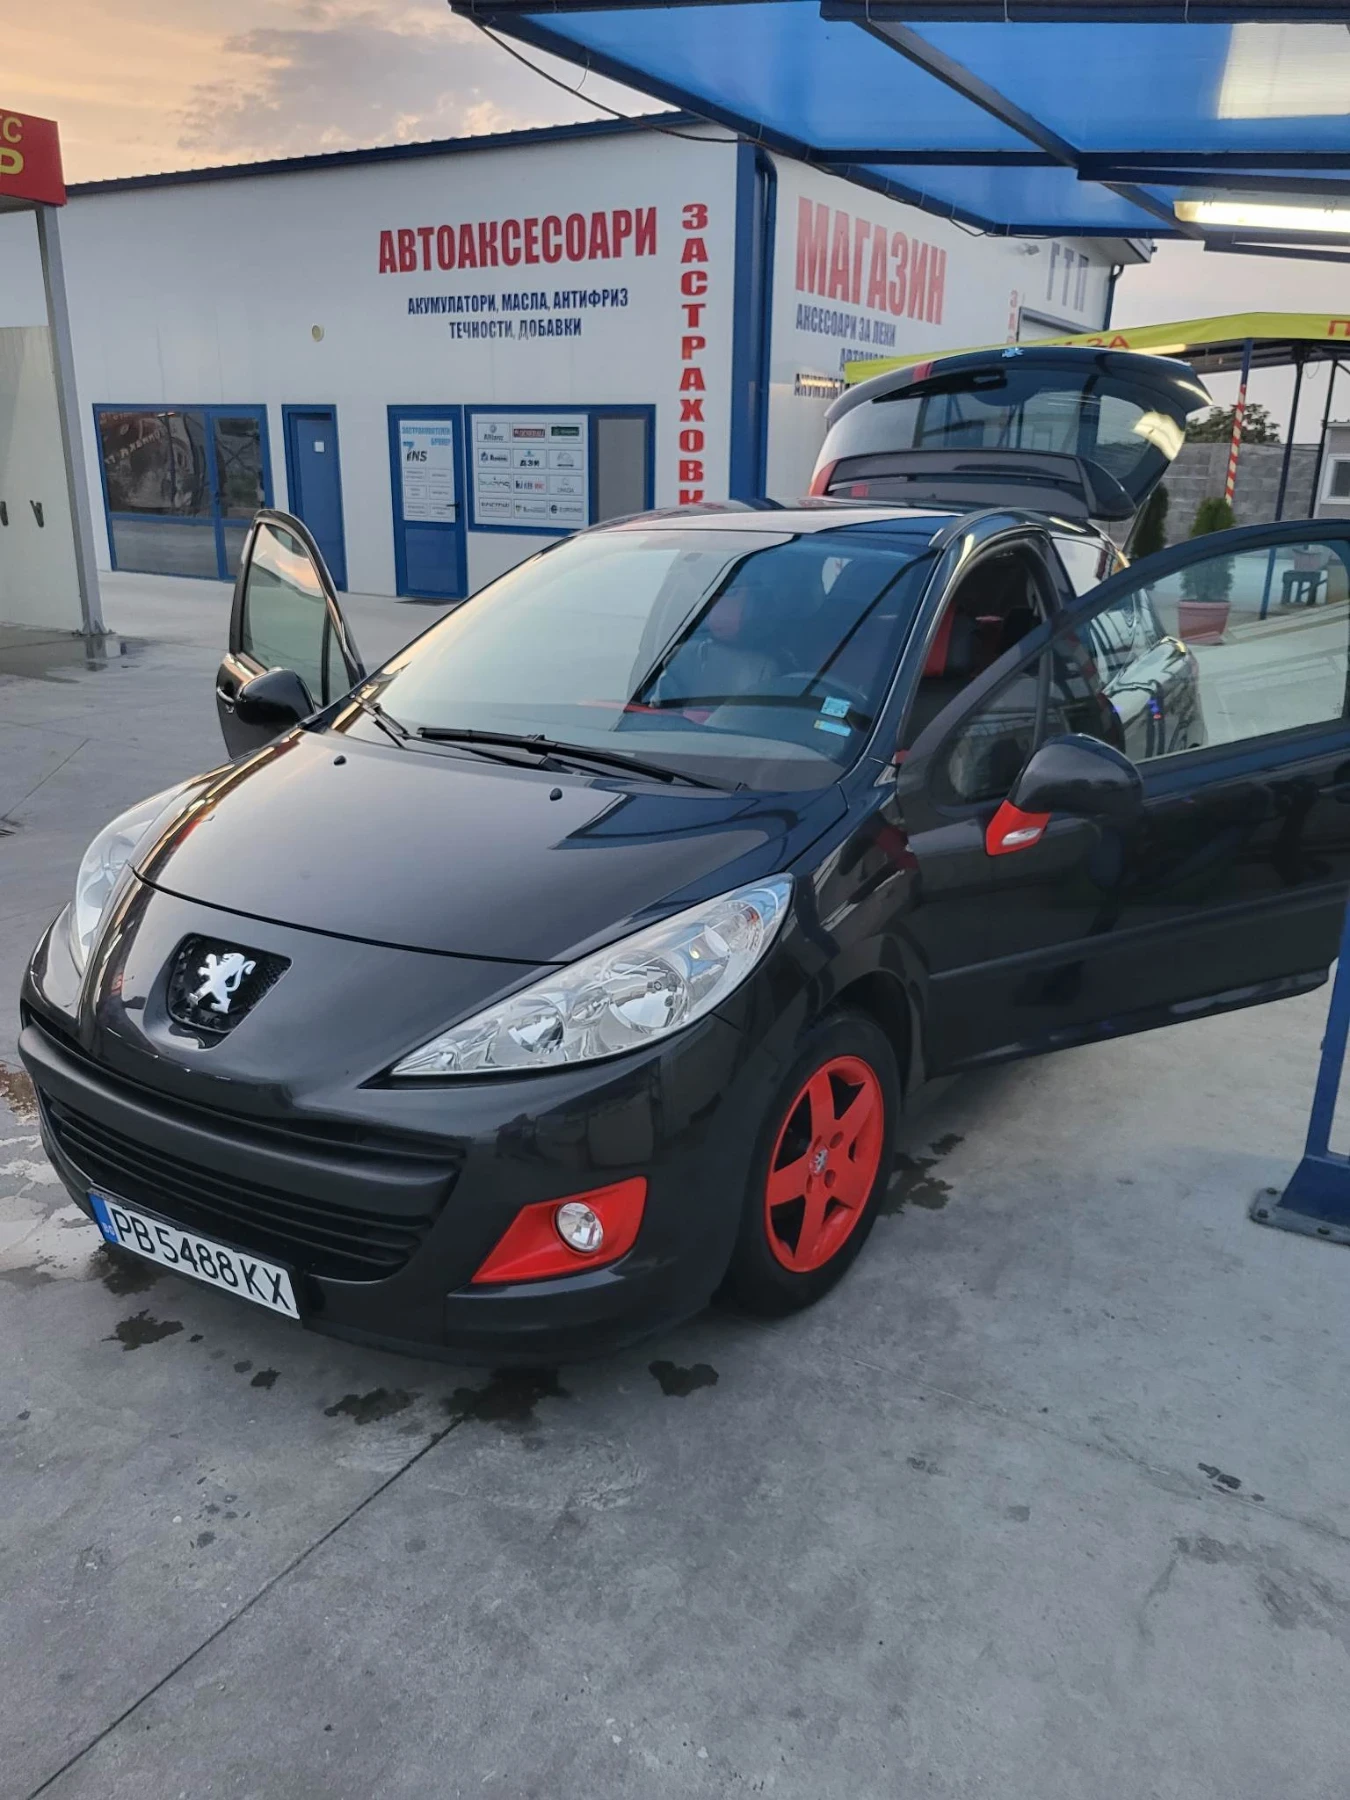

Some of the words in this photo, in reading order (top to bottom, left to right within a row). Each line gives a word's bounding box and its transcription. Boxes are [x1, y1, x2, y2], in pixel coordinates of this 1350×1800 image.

[379, 206, 657, 274] АВТОАКСЕСОАРИ
[795, 195, 947, 326] МАГАЗИН
[408, 294, 499, 315] АКУМУЛАТОРИ,
[502, 291, 550, 312] МАСЛА,
[553, 287, 629, 309] АНТИФРИЗ
[1047, 241, 1090, 313] ГТП
[449, 320, 516, 339] ТЕЧНОСТИ,
[518, 318, 582, 340] ДОБАВКИ
[796, 303, 858, 340] АКСЕСОАРИ
[859, 316, 871, 343] ЗА
